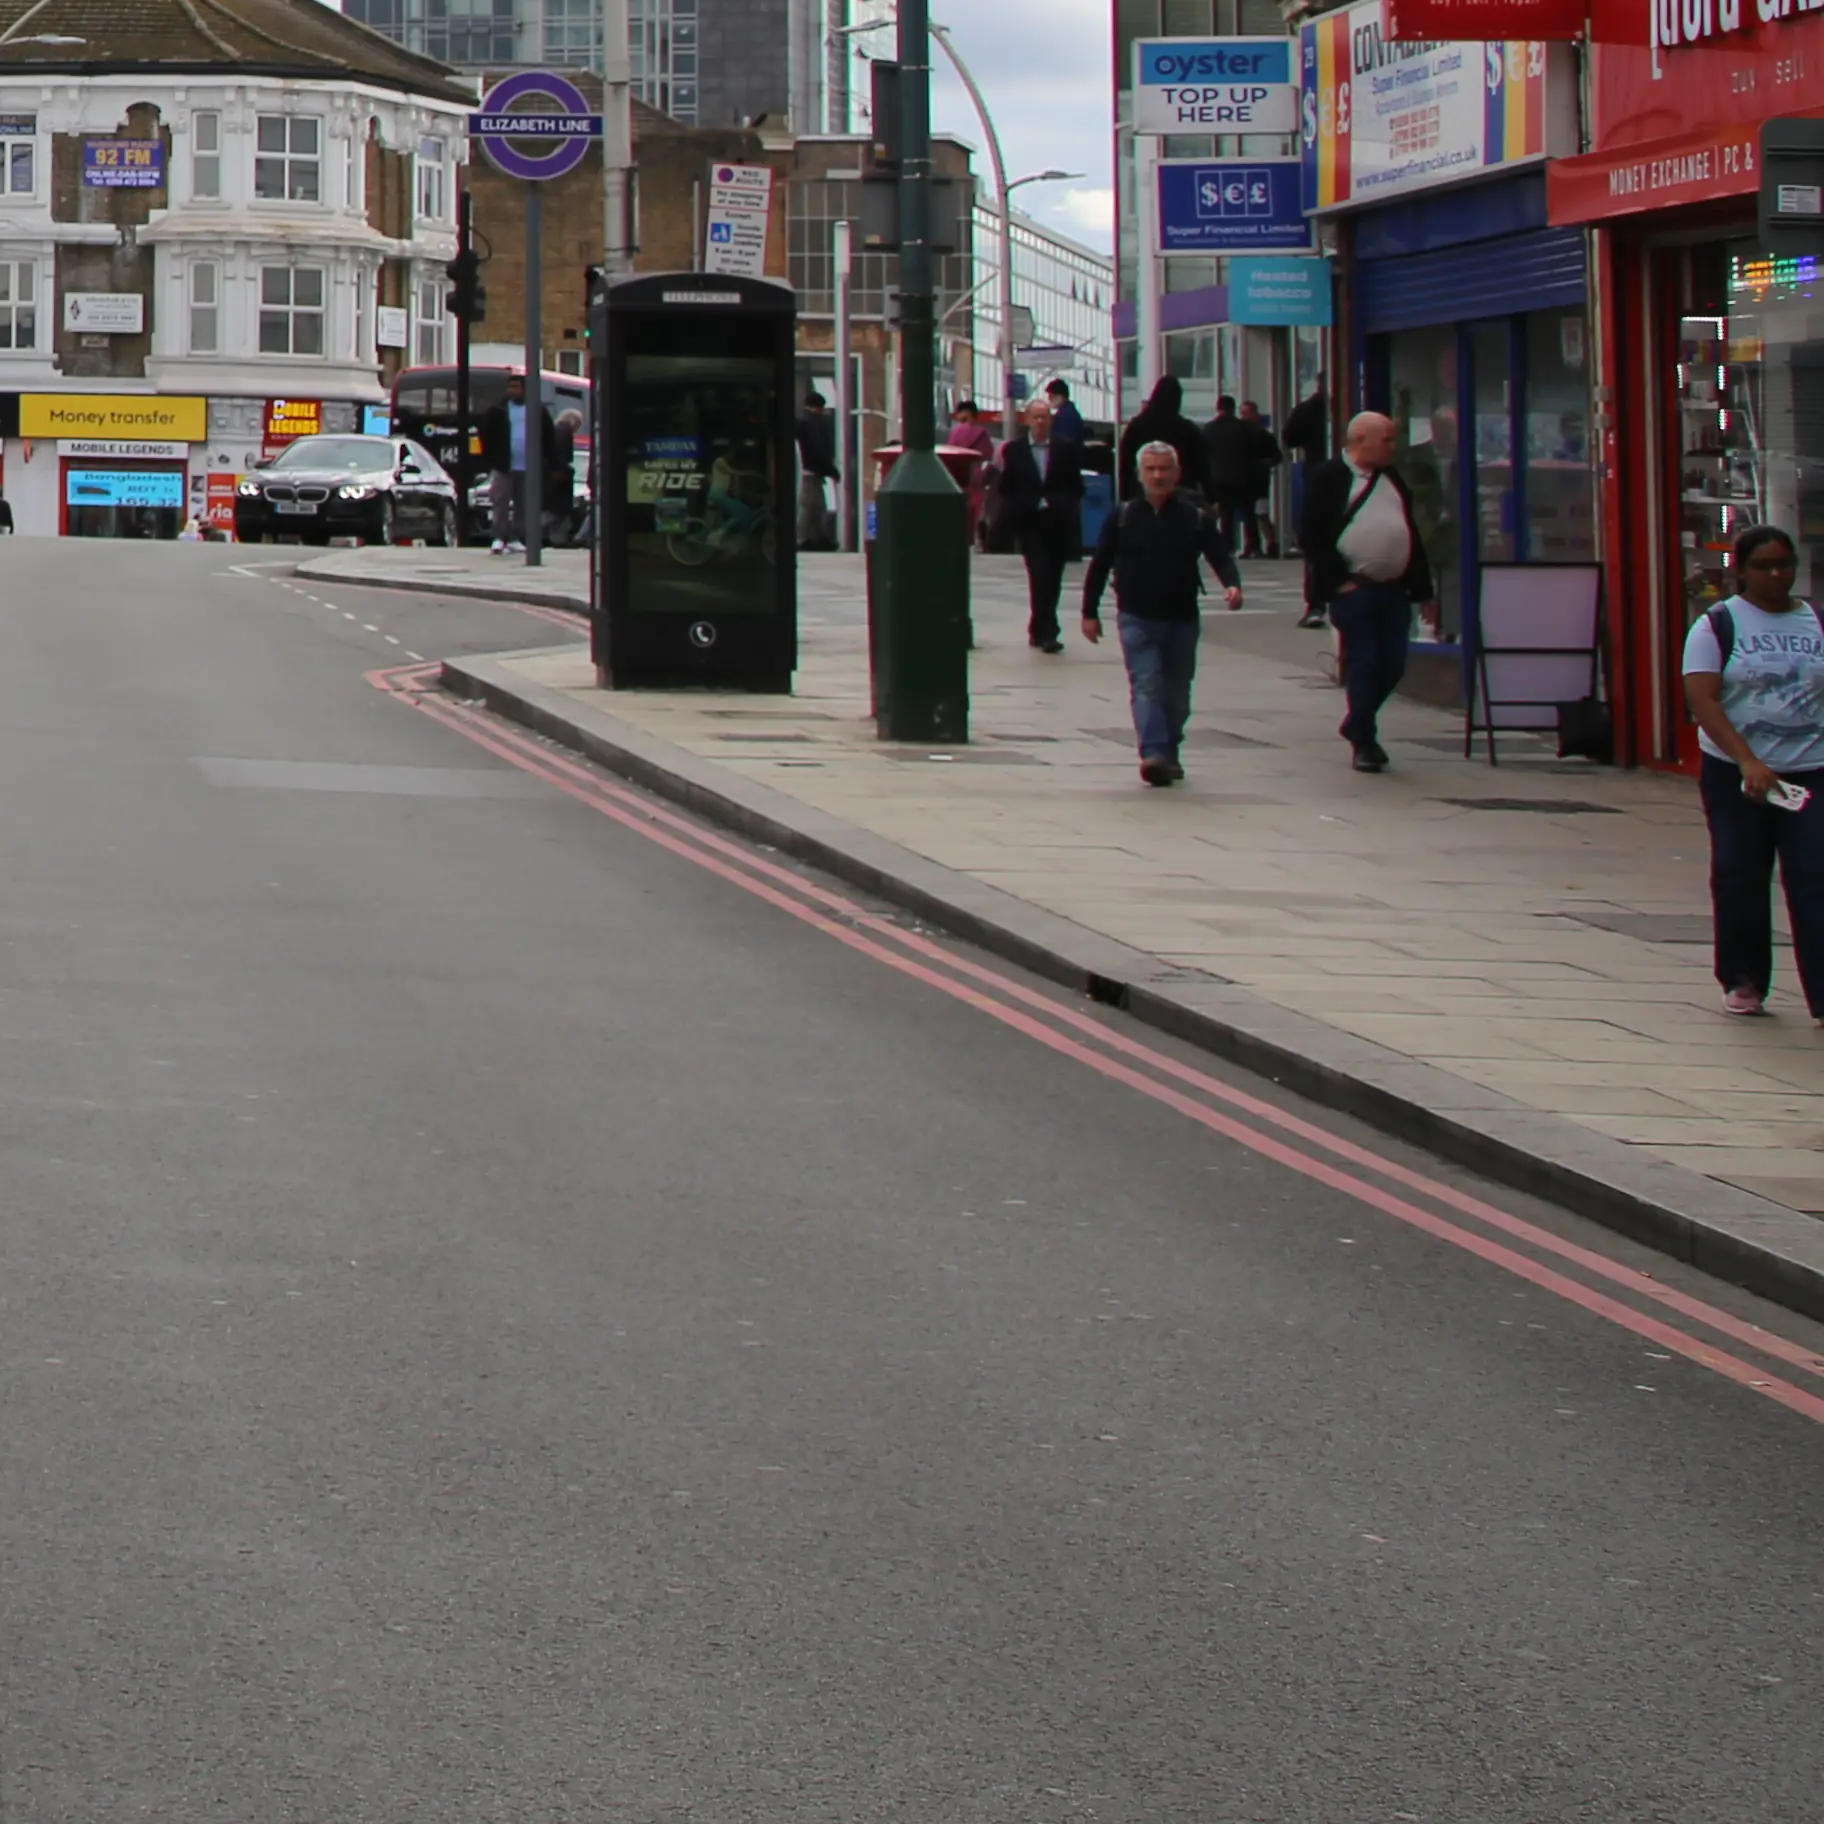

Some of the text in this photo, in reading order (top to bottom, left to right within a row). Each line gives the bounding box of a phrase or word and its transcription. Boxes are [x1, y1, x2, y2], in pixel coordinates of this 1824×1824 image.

[1154, 50, 1266, 82] oyster
[1162, 88, 1268, 104] TOP UP
[1178, 106, 1252, 122] HERE
[1303, 87, 1317, 149] $
[1337, 82, 1350, 134] £
[480, 117, 591, 133] ELIZABETH LINE
[95, 149, 151, 165] 92 FM
[1356, 145, 1477, 189] www.superfinancial.co.uk
[1609, 142, 1754, 196] MONEY EXCHANGE PC &
[1201, 181, 1267, 207] $ € £
[1167, 224, 1305, 236] Super Financial Limited
[1251, 270, 1307, 282] Heated
[1248, 286, 1312, 299] tobacco
[273, 401, 316, 418] MOBILE
[49, 409, 176, 427] Money transfer
[269, 420, 320, 434] LEGENDS
[71, 443, 174, 455] MOBILE LEGENDS
[645, 441, 697, 453] TAMPAX
[638, 473, 705, 490] RIDE
[1739, 635, 1775, 654] LAS
